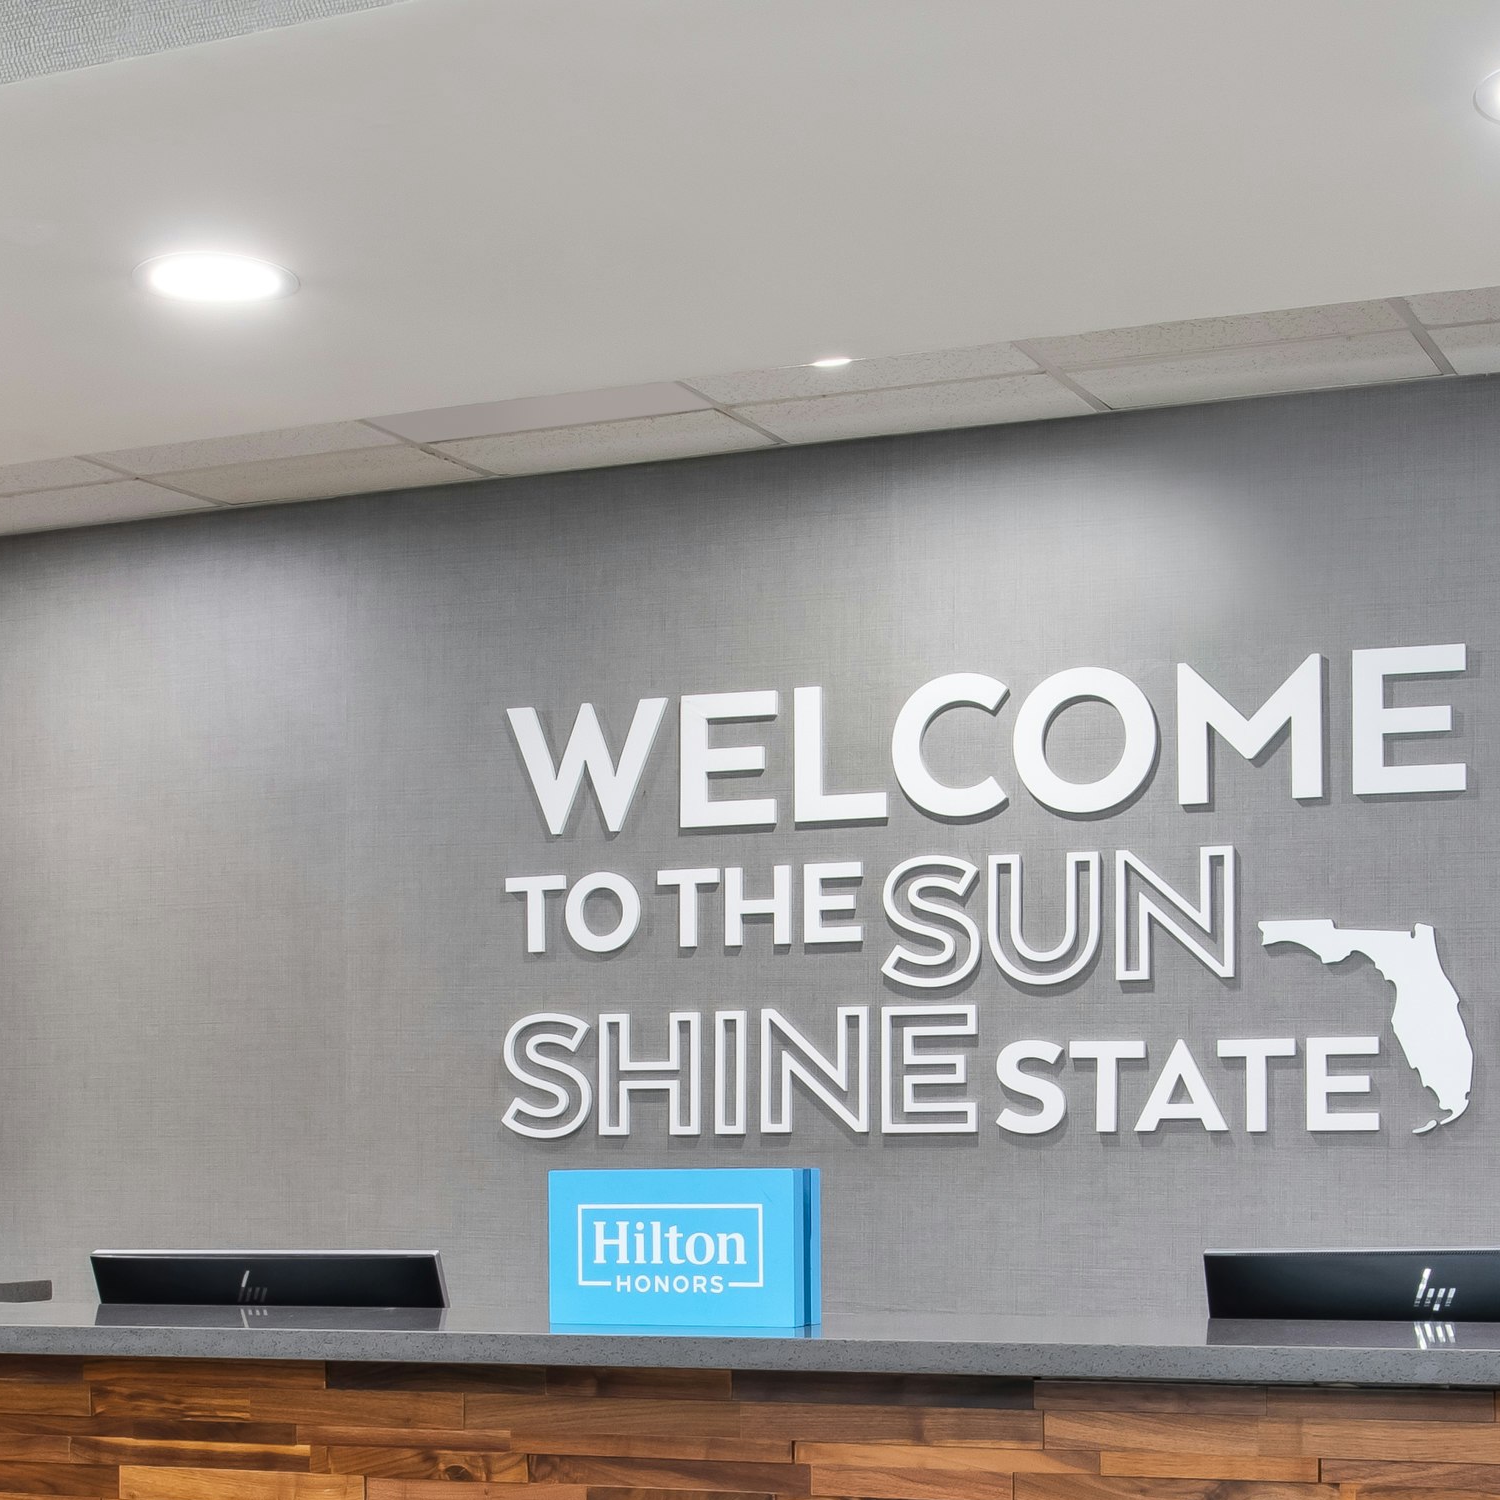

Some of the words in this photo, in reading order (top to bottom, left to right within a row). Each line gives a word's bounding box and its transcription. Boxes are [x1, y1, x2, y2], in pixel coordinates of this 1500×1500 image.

[506, 643, 1467, 835] WELCOME
[505, 871, 643, 954] TO
[656, 860, 864, 948] THE
[880, 844, 1237, 988] SUN
[501, 1004, 979, 1140] SHINE
[995, 1034, 1381, 1136] STATE
[593, 1221, 747, 1265] Hilton
[616, 1275, 724, 1294] HONORS
